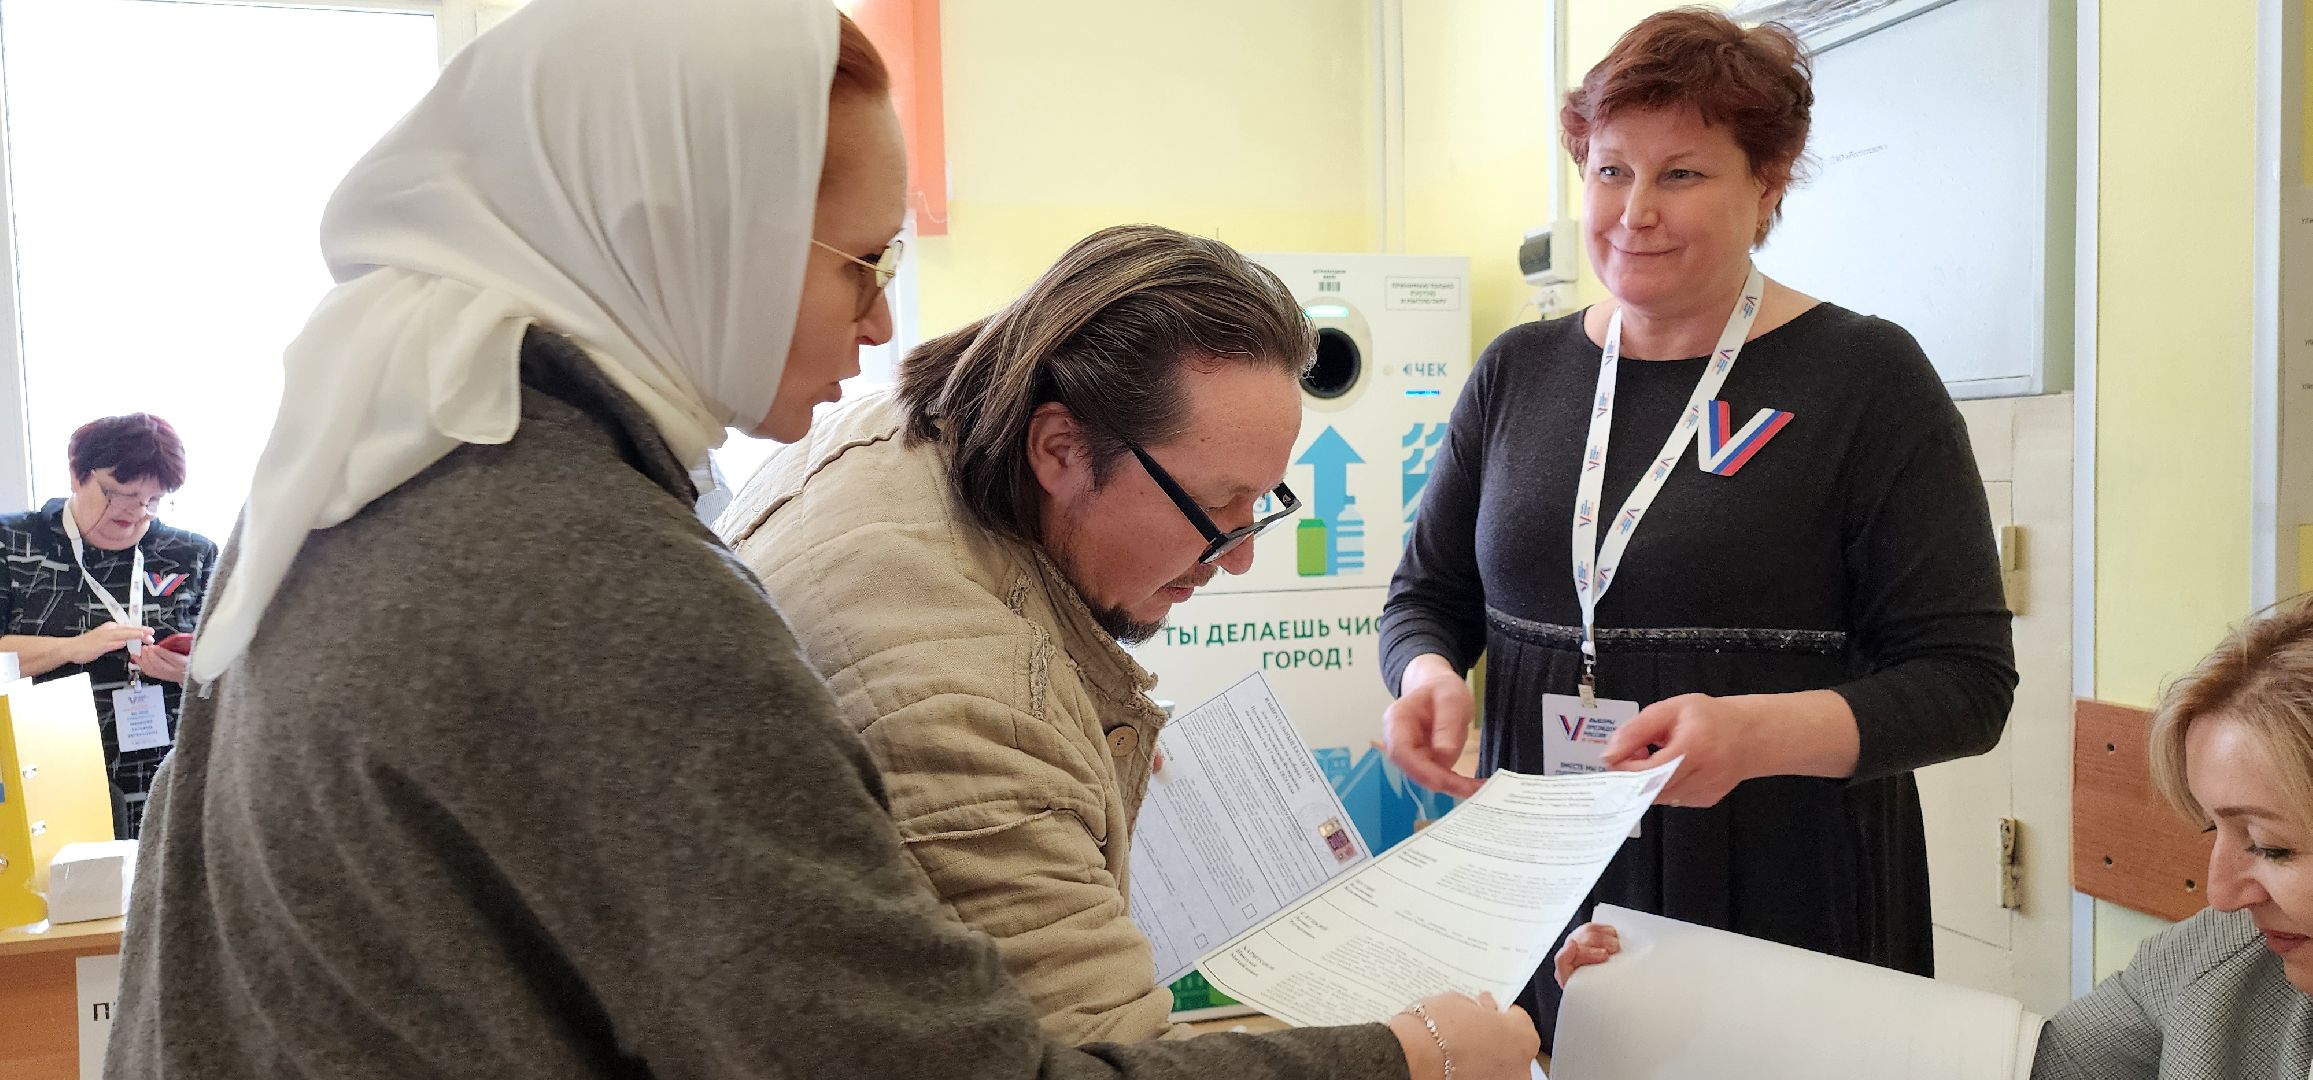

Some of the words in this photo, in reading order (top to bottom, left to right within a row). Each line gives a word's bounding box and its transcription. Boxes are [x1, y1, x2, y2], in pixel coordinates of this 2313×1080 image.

[1415, 362, 1448, 377] ЧЕК
[1165, 625, 1198, 646] ТЫ
[1205, 618, 1330, 647] ДЕЛАЕШЬ
